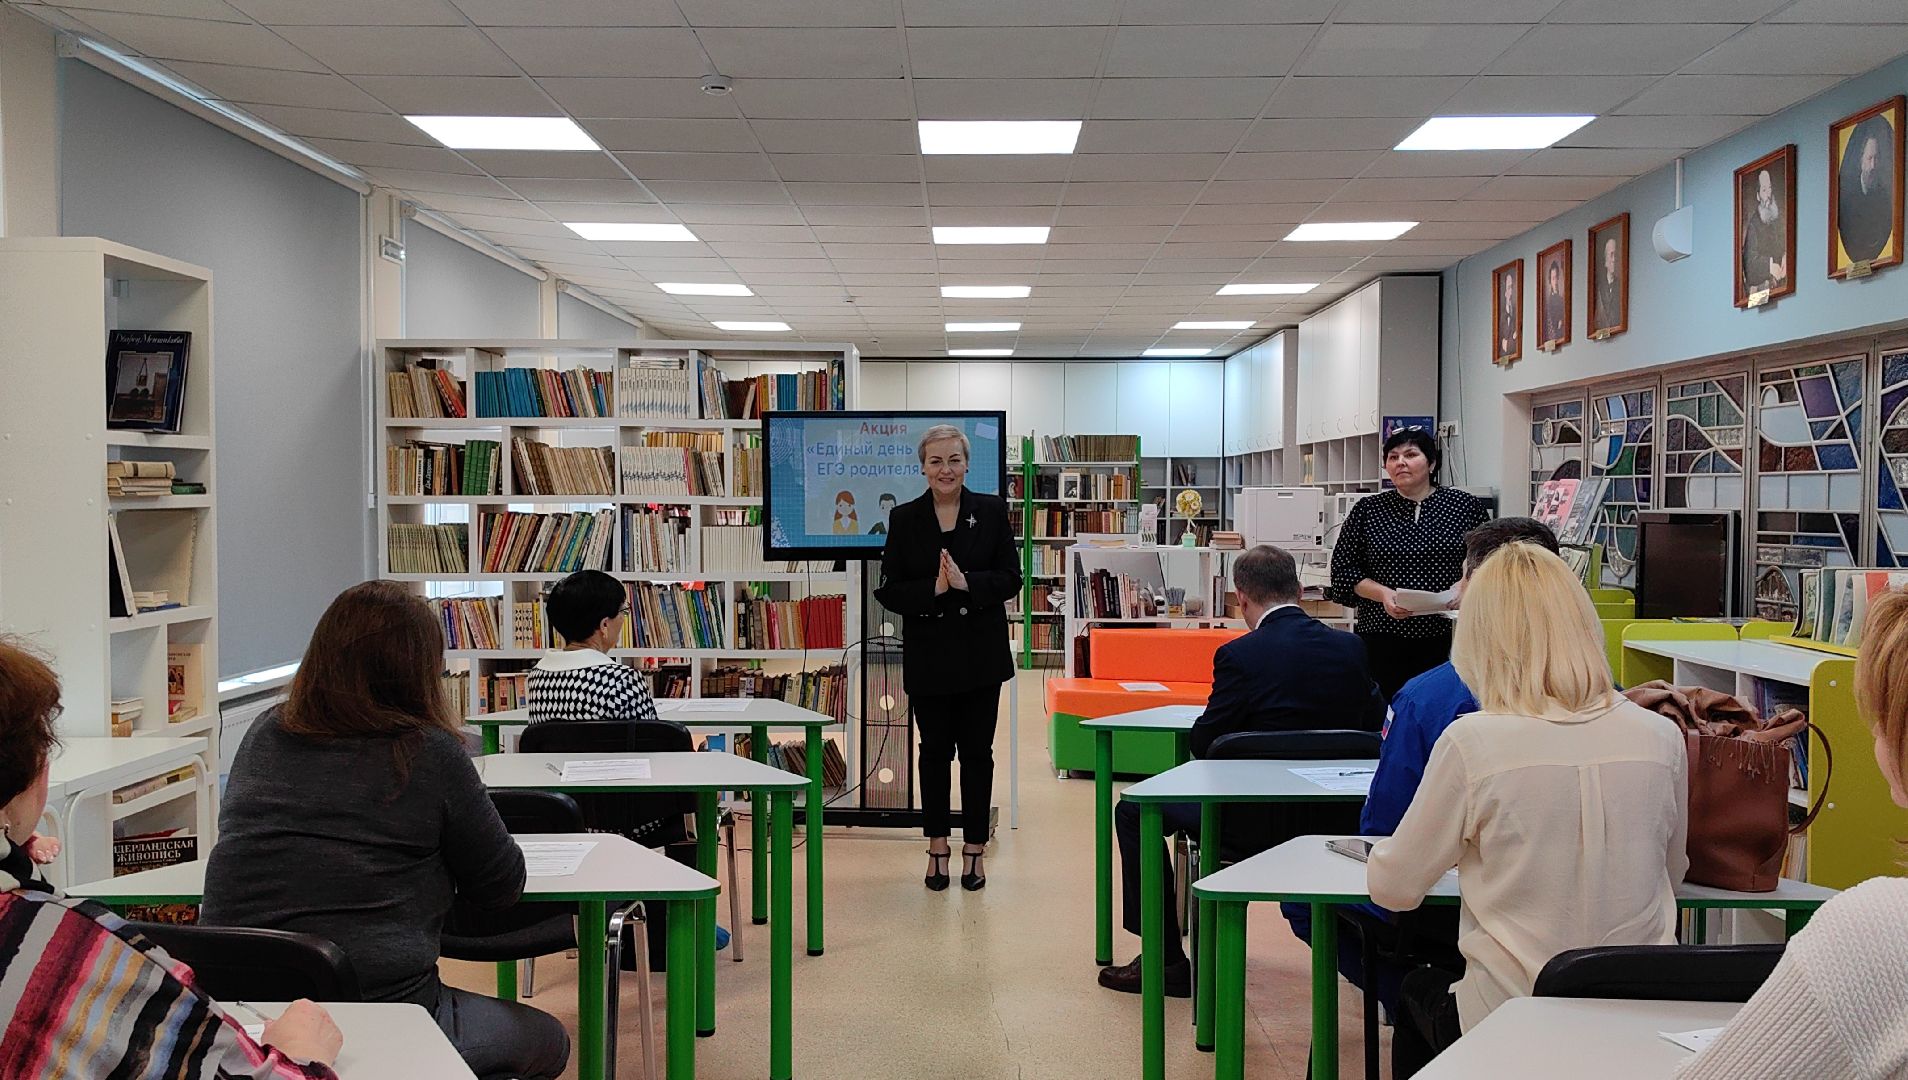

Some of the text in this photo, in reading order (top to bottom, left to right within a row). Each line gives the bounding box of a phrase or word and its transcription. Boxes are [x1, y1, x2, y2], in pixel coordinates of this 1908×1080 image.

[860, 421, 907, 436] Акция
[807, 441, 913, 457] «Единый день
[817, 463, 919, 477] ЕГЭ родителя
[117, 850, 181, 863] ЖИВОПИСЬ
